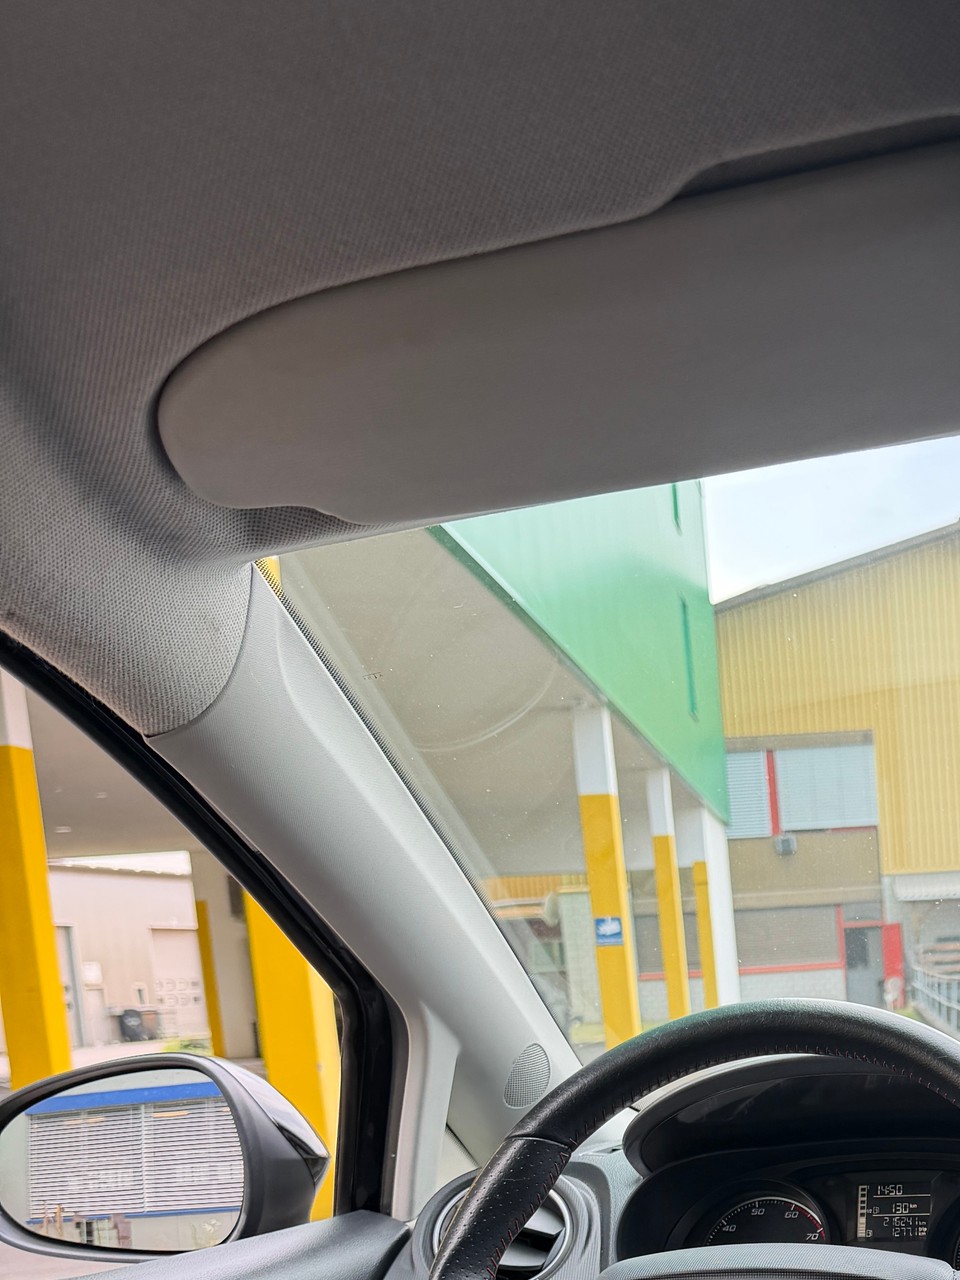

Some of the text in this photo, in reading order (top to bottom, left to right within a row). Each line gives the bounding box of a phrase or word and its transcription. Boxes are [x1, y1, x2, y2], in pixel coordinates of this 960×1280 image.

[877, 1185, 903, 1195] 14:50
[751, 1208, 765, 1216] 50
[892, 1203, 909, 1214] 130
[784, 1211, 799, 1219] 60
[883, 1217, 918, 1227] 216241
[722, 1224, 736, 1232] 40
[805, 1233, 819, 1241] 70
